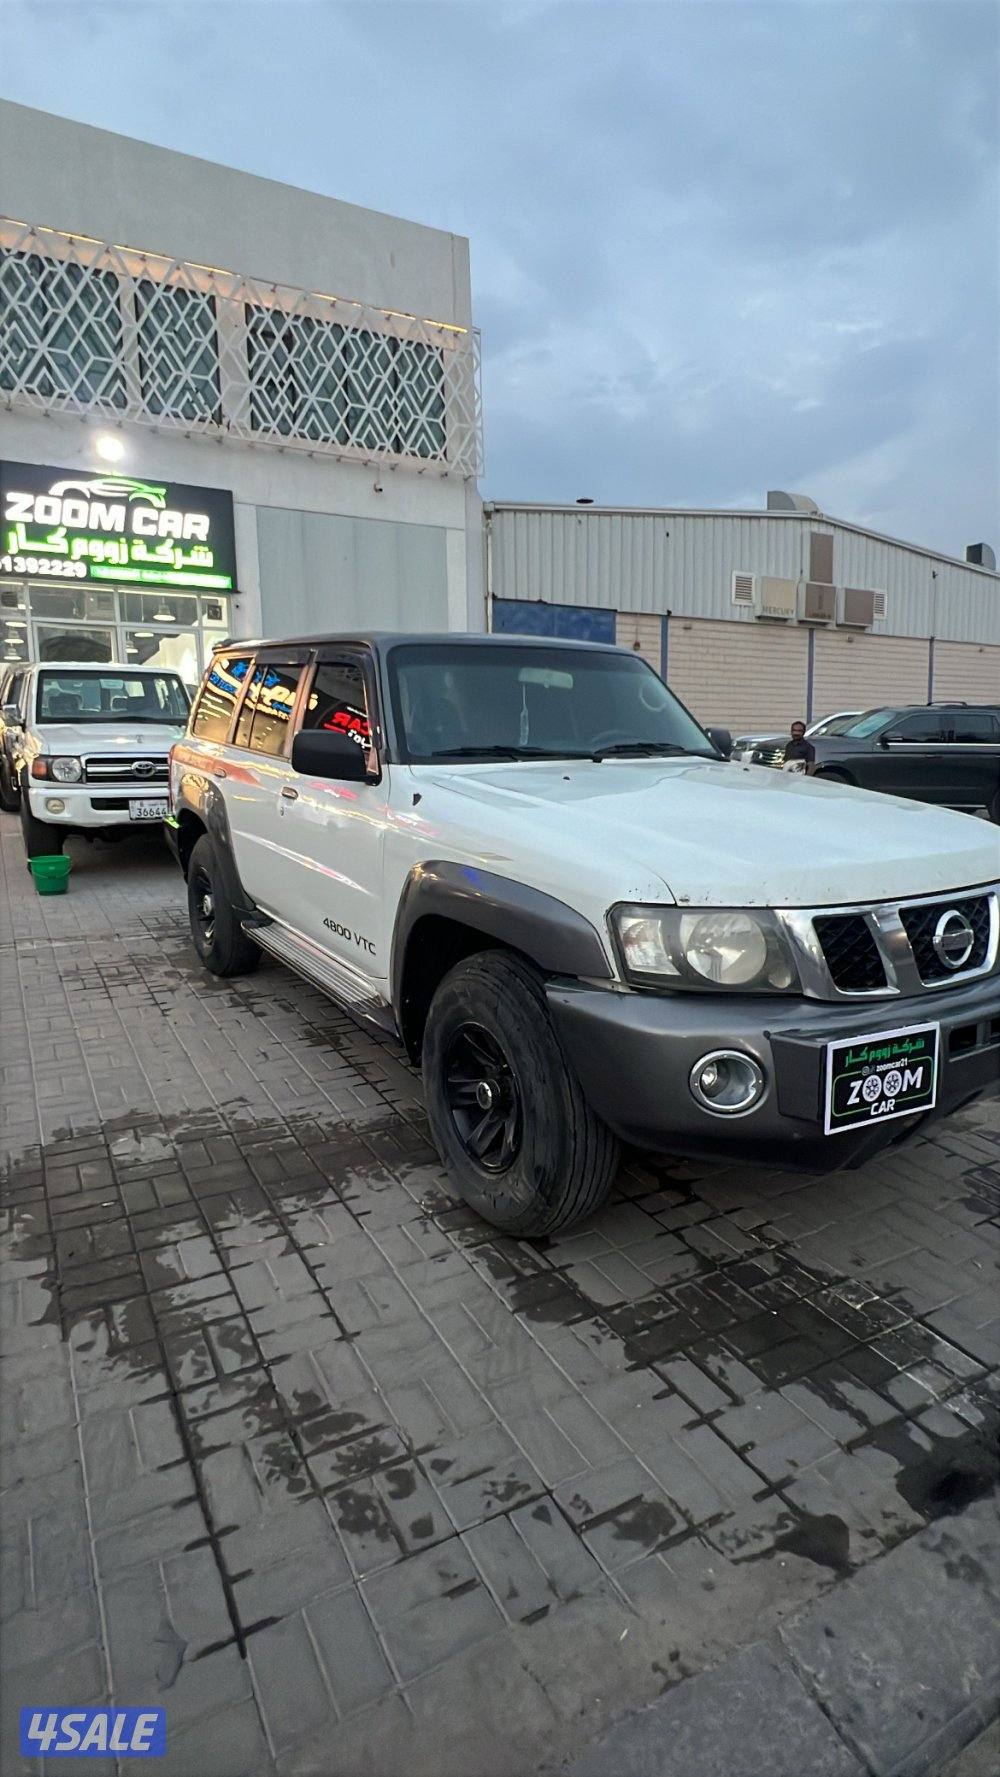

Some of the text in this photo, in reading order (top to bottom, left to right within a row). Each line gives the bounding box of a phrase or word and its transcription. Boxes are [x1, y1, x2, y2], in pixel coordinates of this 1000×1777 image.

[5, 492, 210, 542] ZOOM CAR
[7, 522, 214, 570] شركة زووم كار
[0, 555, 87, 578] 1392229
[323, 917, 377, 956] 4800 VTC
[845, 1046, 869, 1068] كار
[892, 1038, 925, 1054] شركة
[876, 1057, 908, 1072] zoomcar21
[847, 1066, 924, 1105] ZOOM
[870, 1098, 896, 1116] CAR
